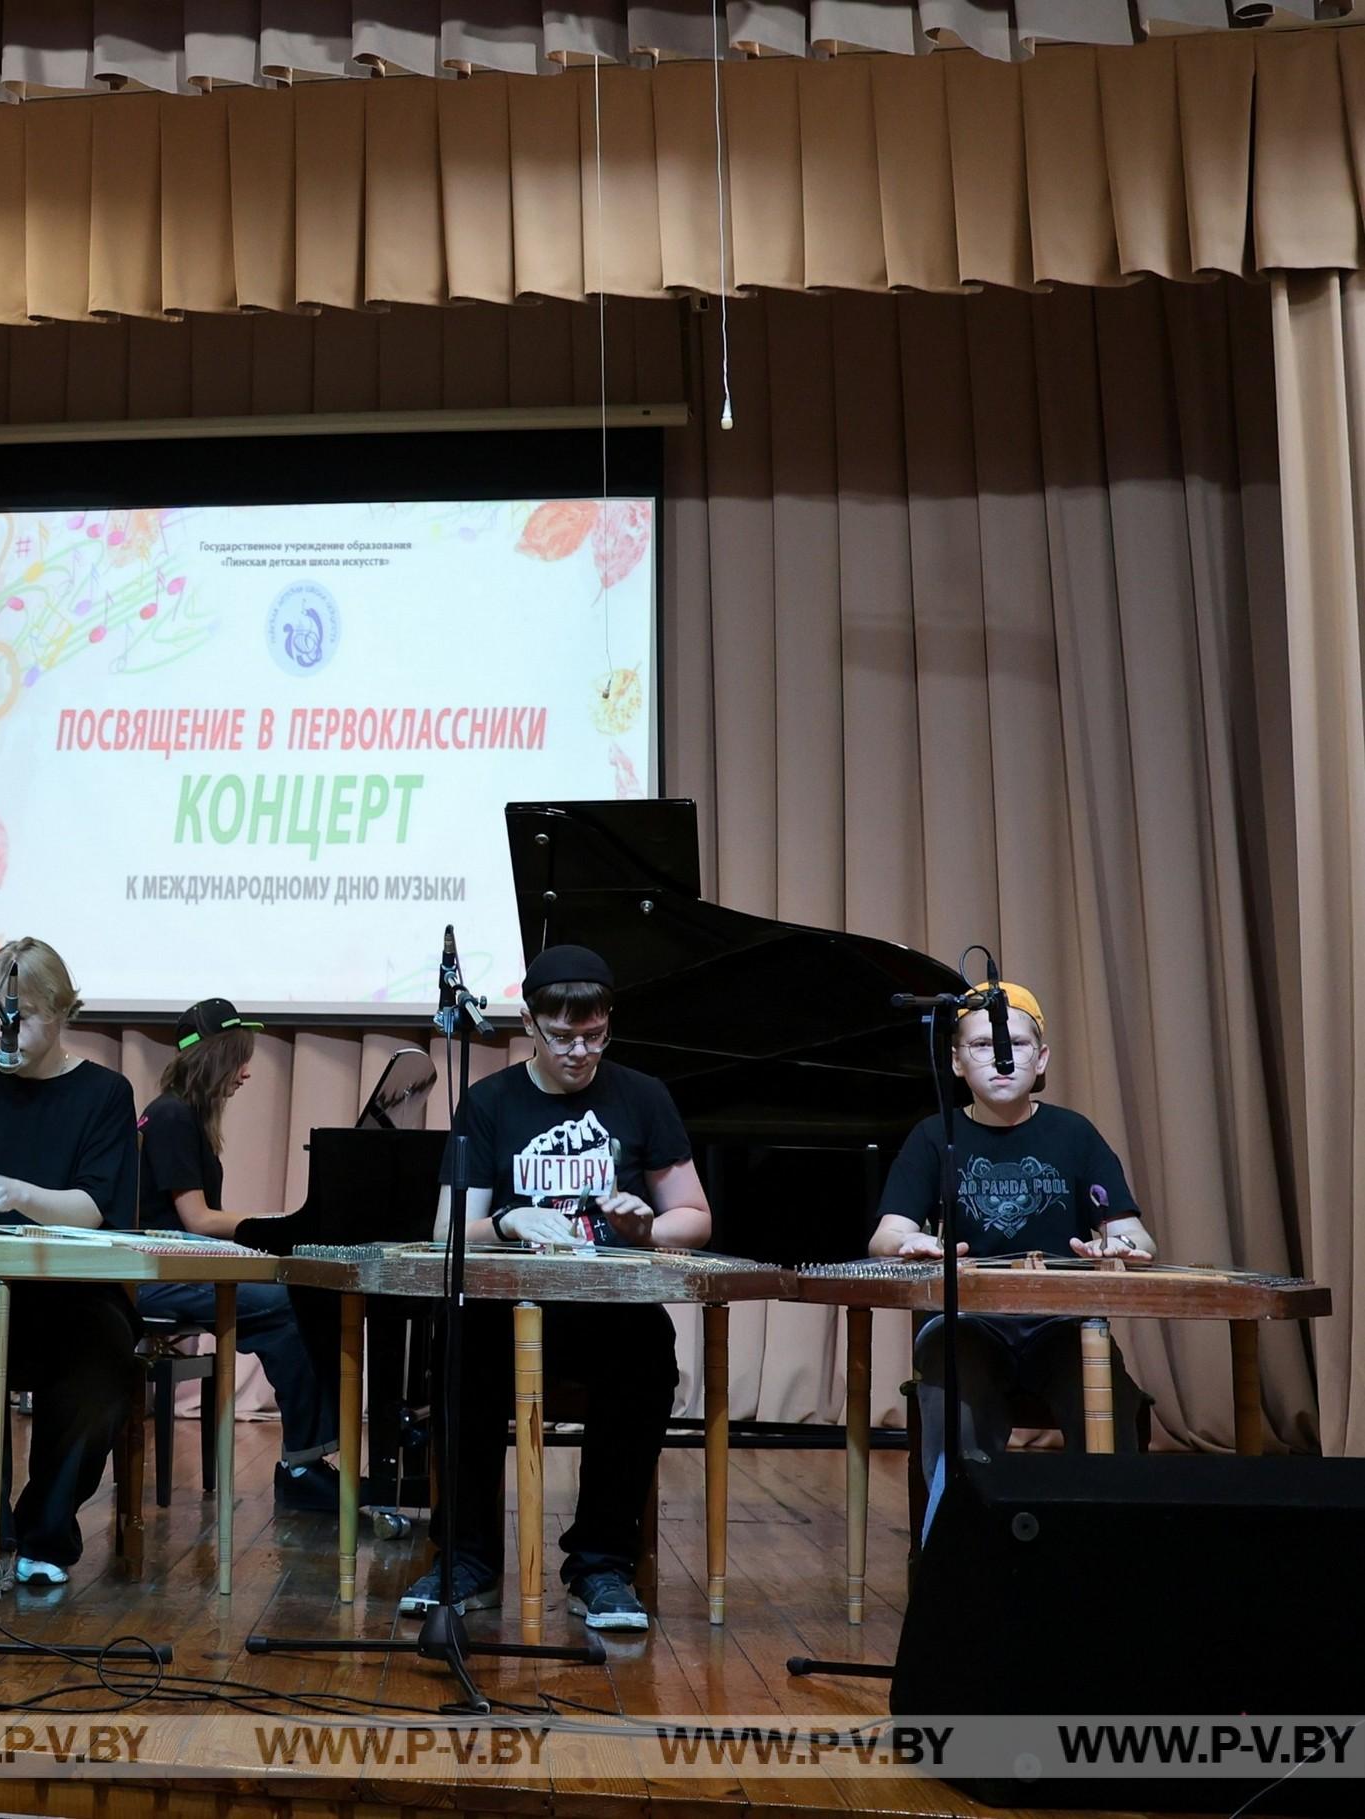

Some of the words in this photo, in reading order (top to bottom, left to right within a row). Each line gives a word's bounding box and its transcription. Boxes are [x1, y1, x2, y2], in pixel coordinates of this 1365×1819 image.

[199, 541, 282, 553] Государственное
[285, 542, 345, 553] учреждение
[347, 540, 412, 552] образования
[221, 557, 267, 567] «Пинская
[269, 557, 307, 567] детская
[309, 557, 340, 566] школа
[342, 557, 389, 567] искусств»
[56, 708, 245, 760] ПОСВЯЩЕНИЕ
[257, 708, 275, 750] В
[287, 706, 547, 750] ПЕРВОКЛАССНИКИ
[173, 774, 424, 861] КОНЦЕРТ
[126, 875, 137, 900] К
[142, 875, 330, 905] МЕЖДУНАРОДНОМУ
[334, 875, 380, 906] ДНЮ
[384, 876, 466, 902] МУЗЫКИ
[519, 1158, 608, 1191] VICTORY
[958, 1180, 977, 1195] AD
[981, 1179, 1029, 1195] PANDA
[1033, 1178, 1070, 1195] POOL
